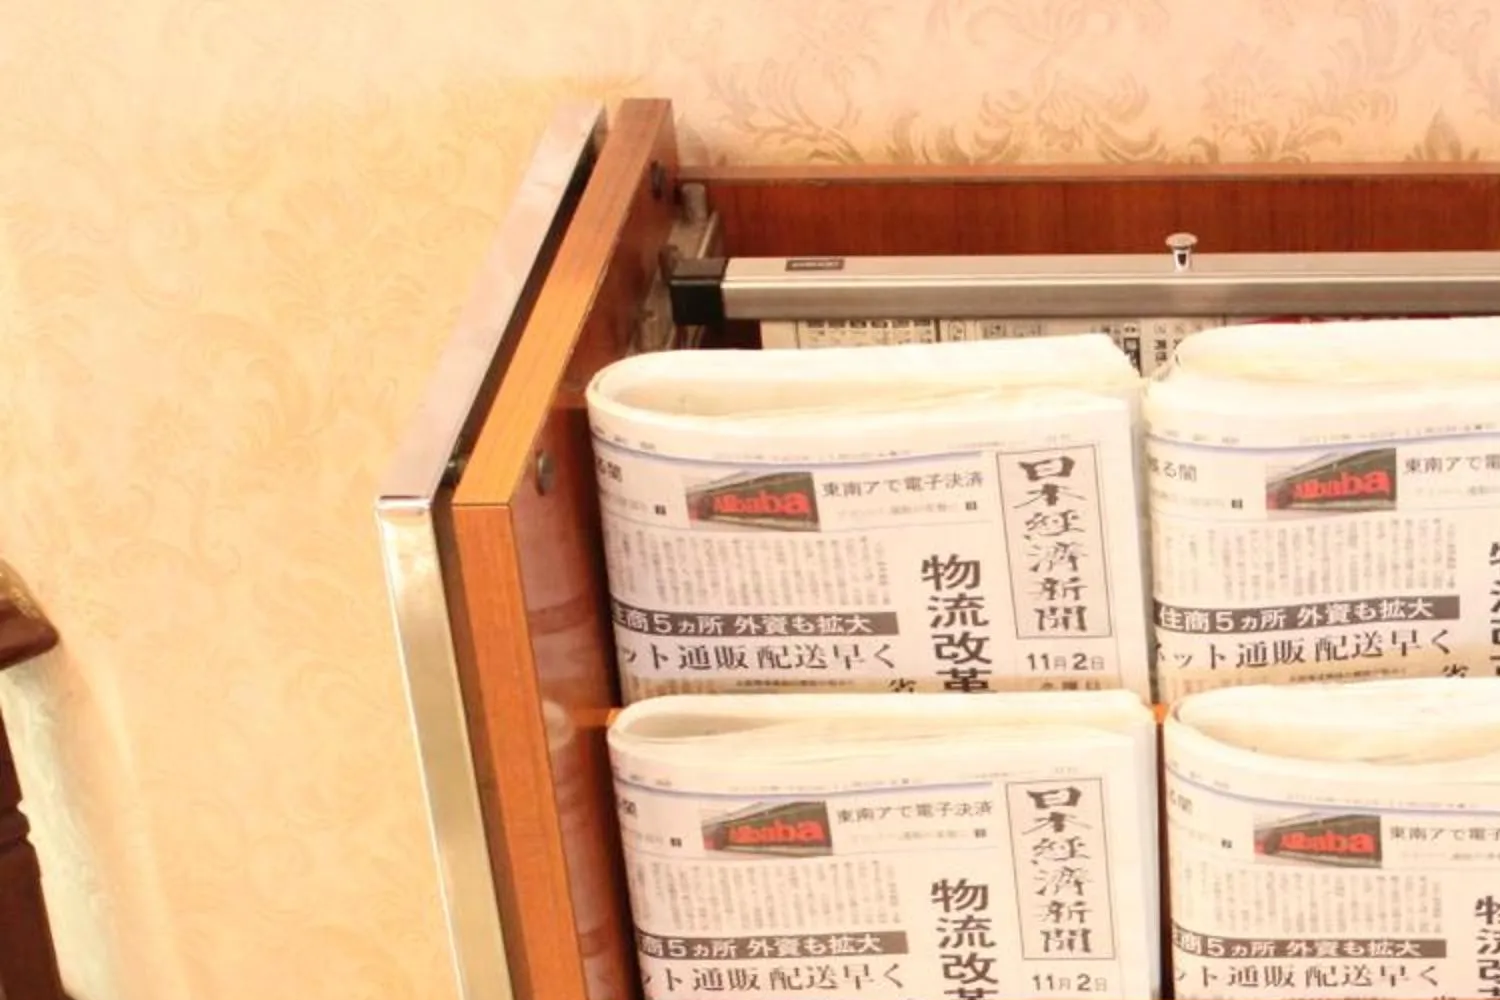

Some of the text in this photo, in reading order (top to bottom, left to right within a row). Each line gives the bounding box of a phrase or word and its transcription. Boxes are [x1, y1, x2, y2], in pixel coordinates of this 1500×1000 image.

[821, 471, 984, 498] 東南アで電子決済
[921, 553, 994, 692] 物流改革
[837, 800, 993, 825] 東南アで電子決済
